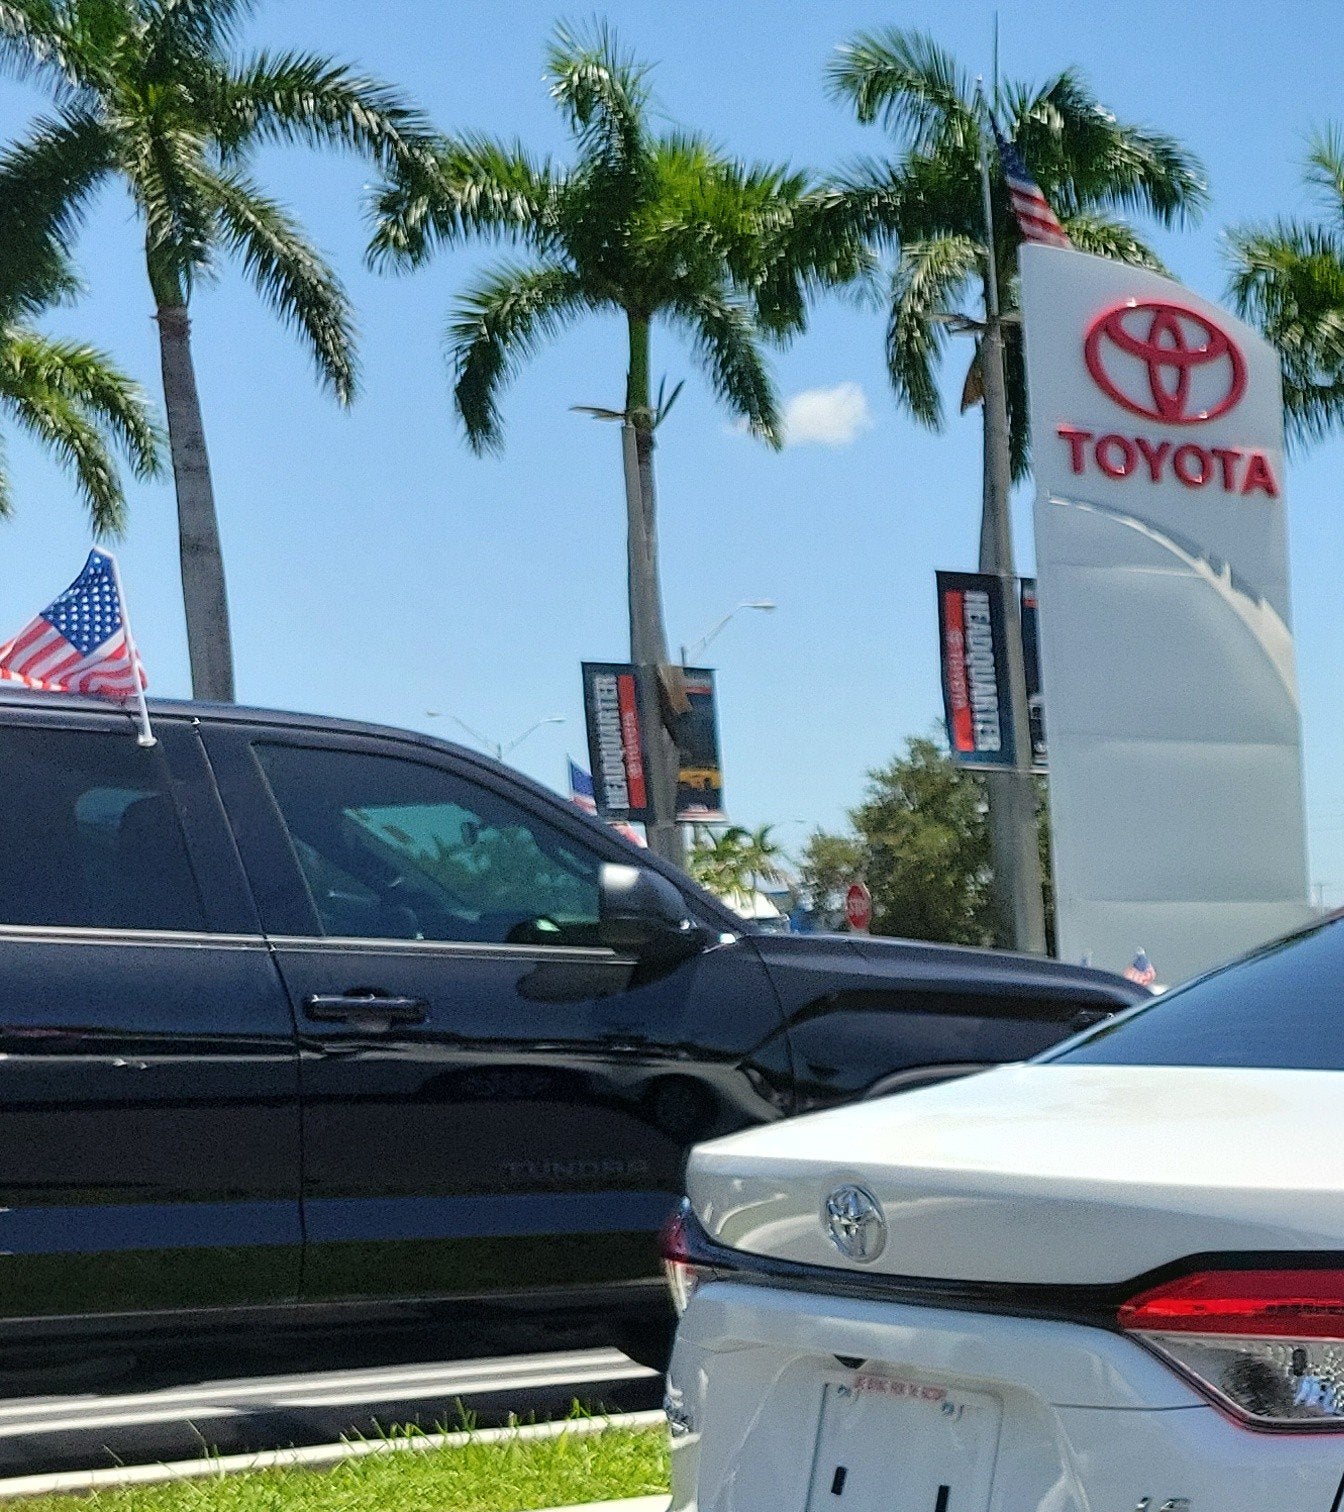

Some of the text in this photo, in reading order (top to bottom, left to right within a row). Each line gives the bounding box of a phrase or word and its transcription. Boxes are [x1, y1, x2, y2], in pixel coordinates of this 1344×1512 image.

[1056, 424, 1280, 497] TOYOTA
[963, 590, 1001, 751] HEADQUARTER
[593, 674, 631, 809] HEADQUARTER
[499, 1158, 649, 1178] TUNDRA
